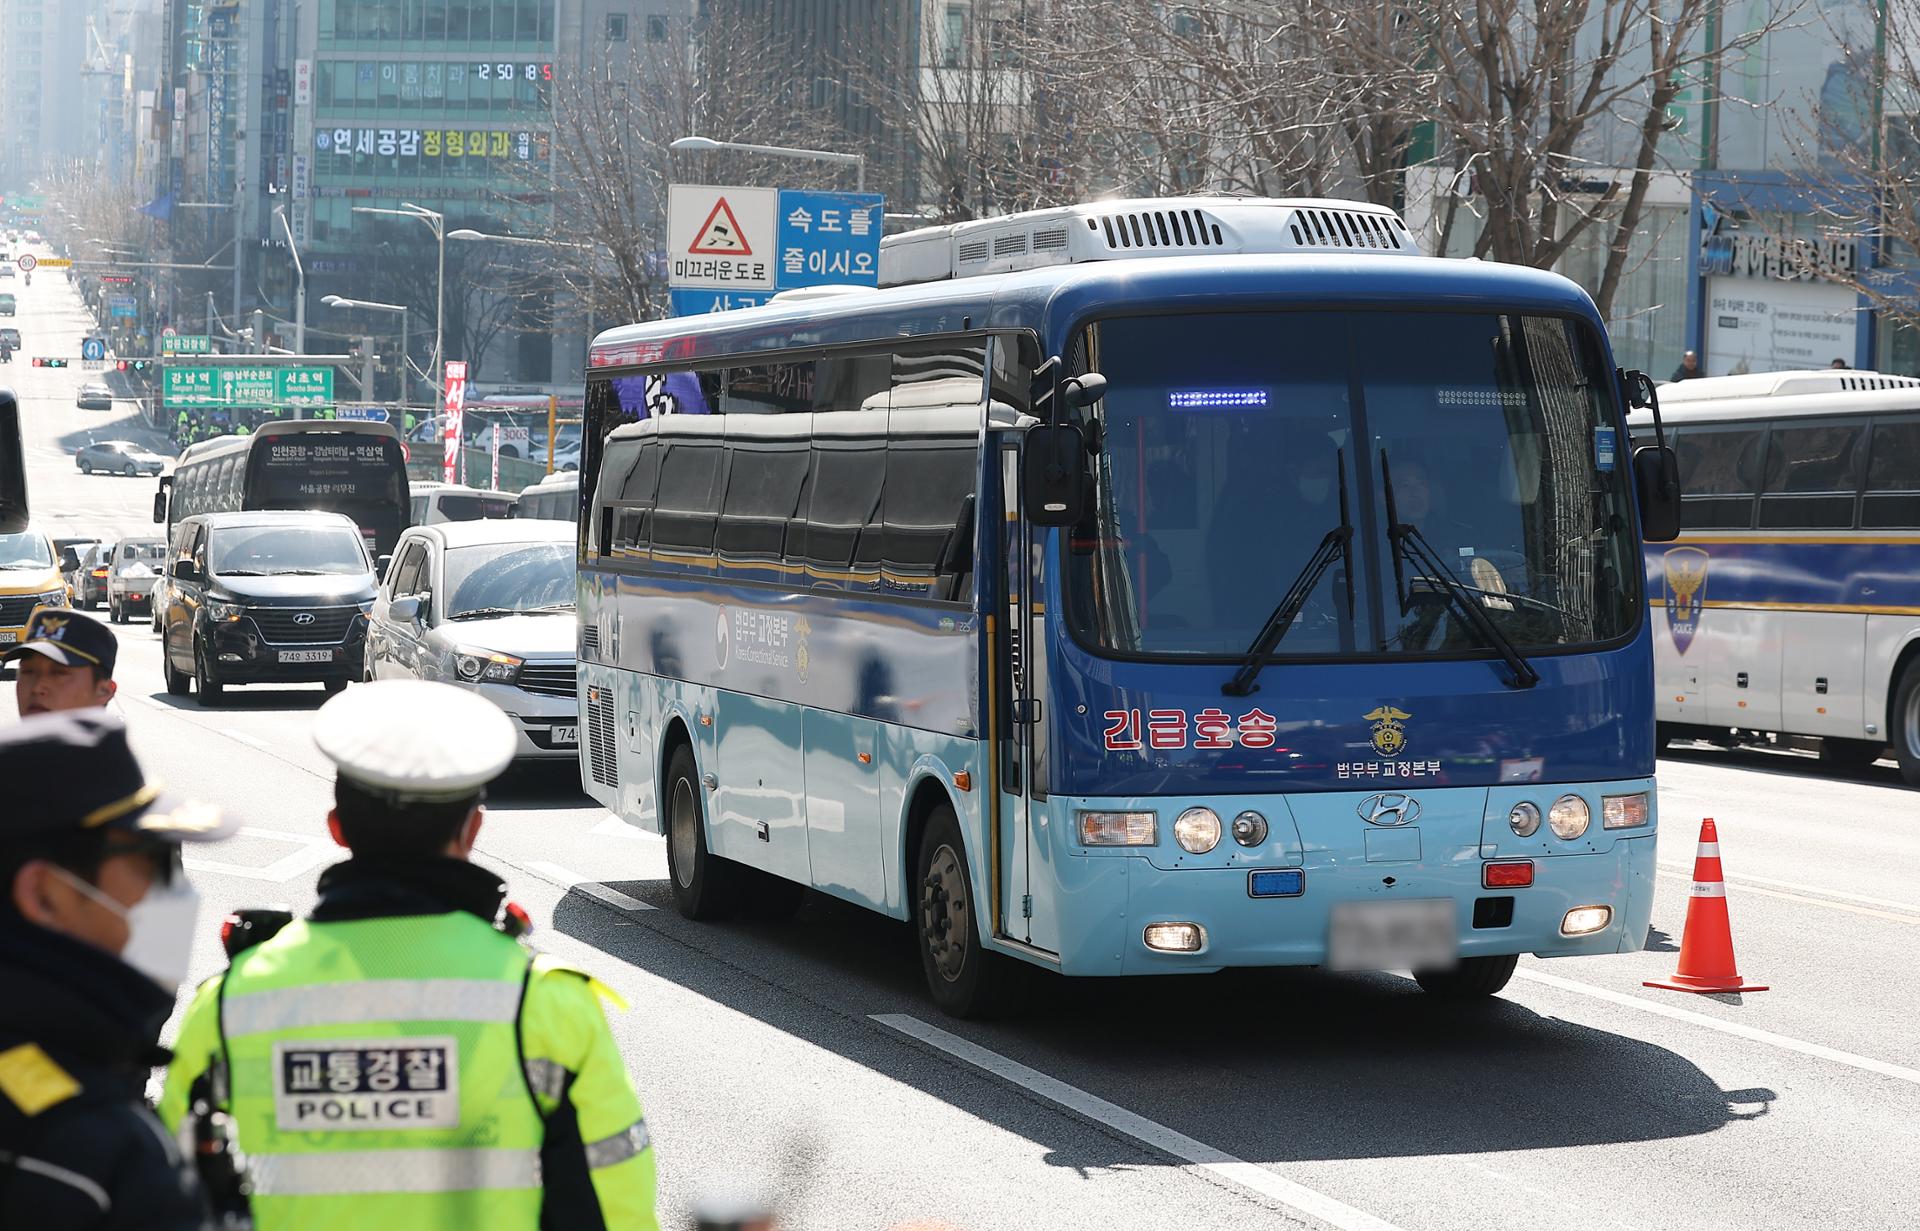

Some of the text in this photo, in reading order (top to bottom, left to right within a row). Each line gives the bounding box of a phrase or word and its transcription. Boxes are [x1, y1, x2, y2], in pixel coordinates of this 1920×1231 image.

[497, 64, 513, 80] 50
[333, 129, 419, 156] 연세공감
[423, 131, 511, 157] 정형외과
[788, 206, 873, 236] 속도를
[783, 247, 874, 276] 줄이시오
[171, 372, 210, 385] 강남역
[285, 372, 324, 385] 서초역
[271, 445, 384, 457] 인천공항 강남터미널 역삼역
[735, 610, 789, 648] 법무부 교정본부
[1673, 623, 1693, 634] POLICE
[305, 651, 328, 661] 3319
[1104, 708, 1277, 751] 긴급호송
[1337, 760, 1441, 779] 법무부 교정본부
[289, 1050, 442, 1092] 교통경찰
[297, 1100, 434, 1121] POLICE
